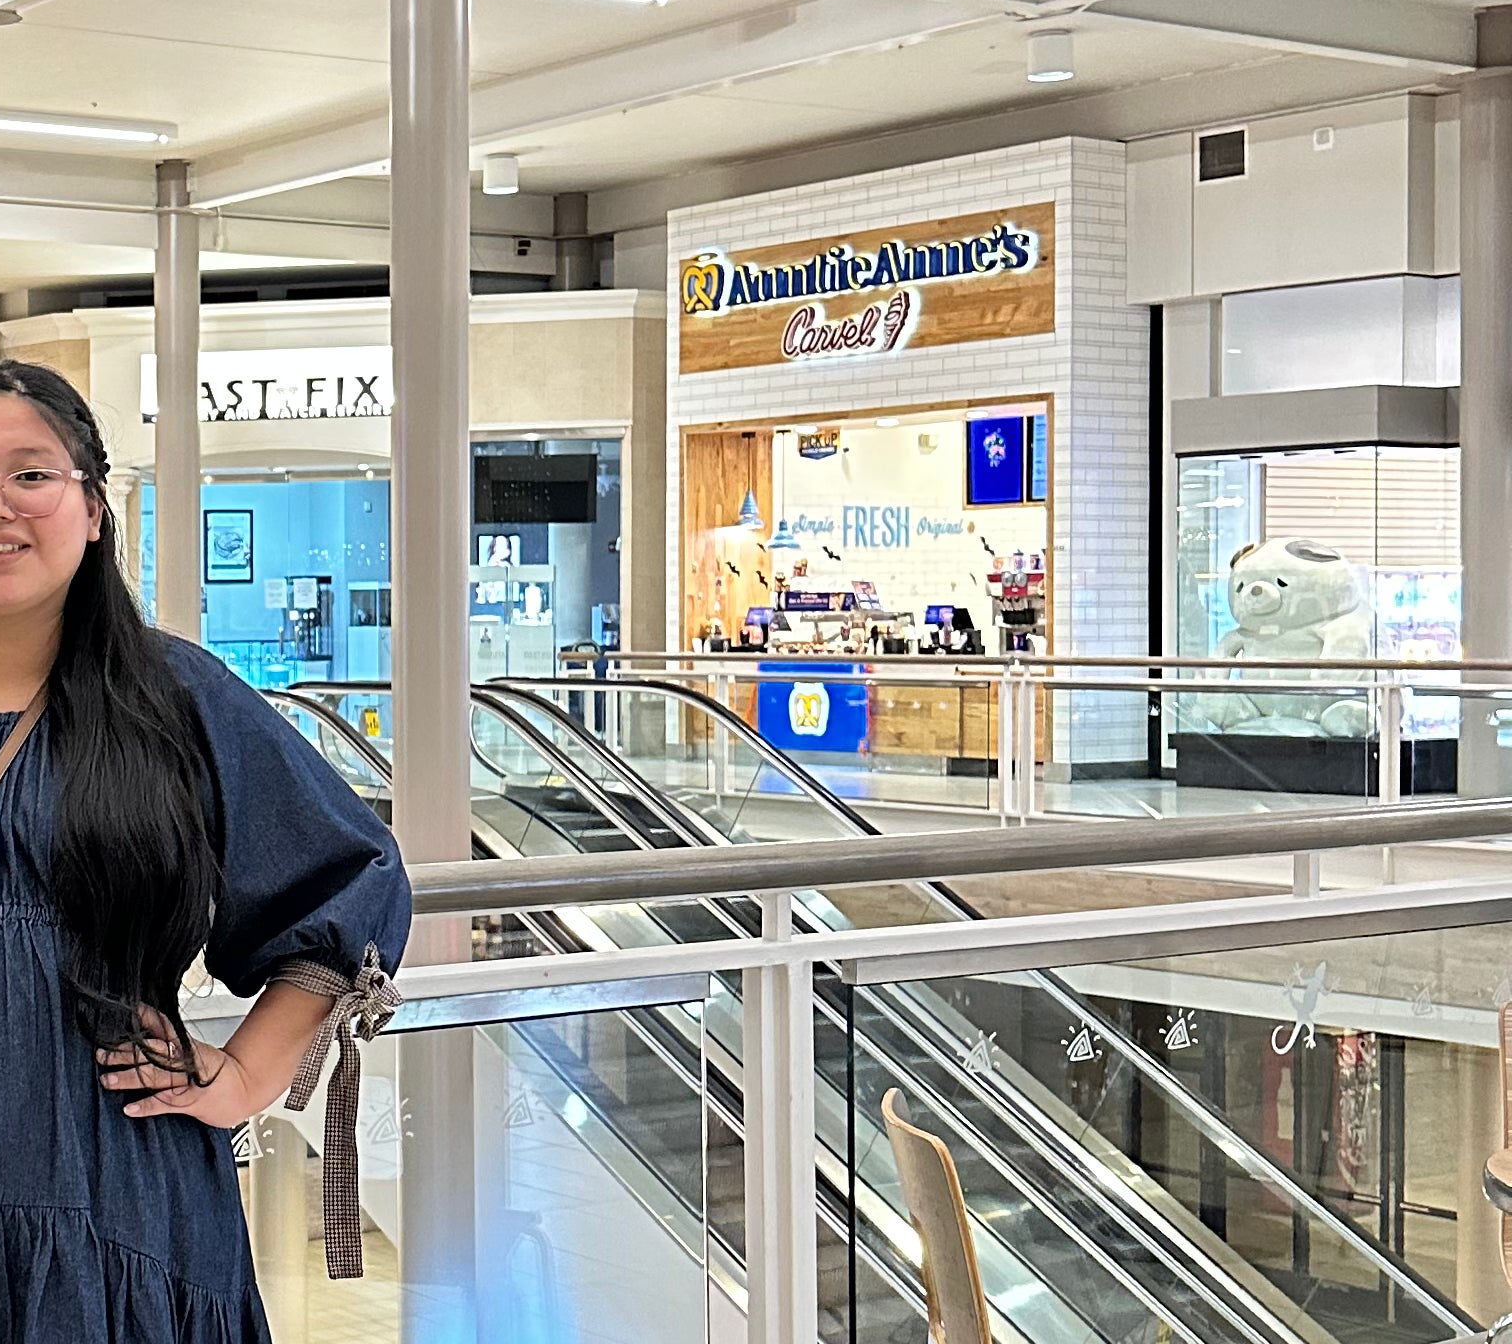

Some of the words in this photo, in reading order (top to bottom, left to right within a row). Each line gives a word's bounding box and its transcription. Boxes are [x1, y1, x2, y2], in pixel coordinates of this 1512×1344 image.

[727, 244, 872, 306] Auntie
[868, 224, 1031, 286] Anne's
[782, 306, 882, 356] Carvel
[201, 380, 277, 413] AST
[306, 376, 379, 410] FIX
[841, 505, 911, 549] FRESH
